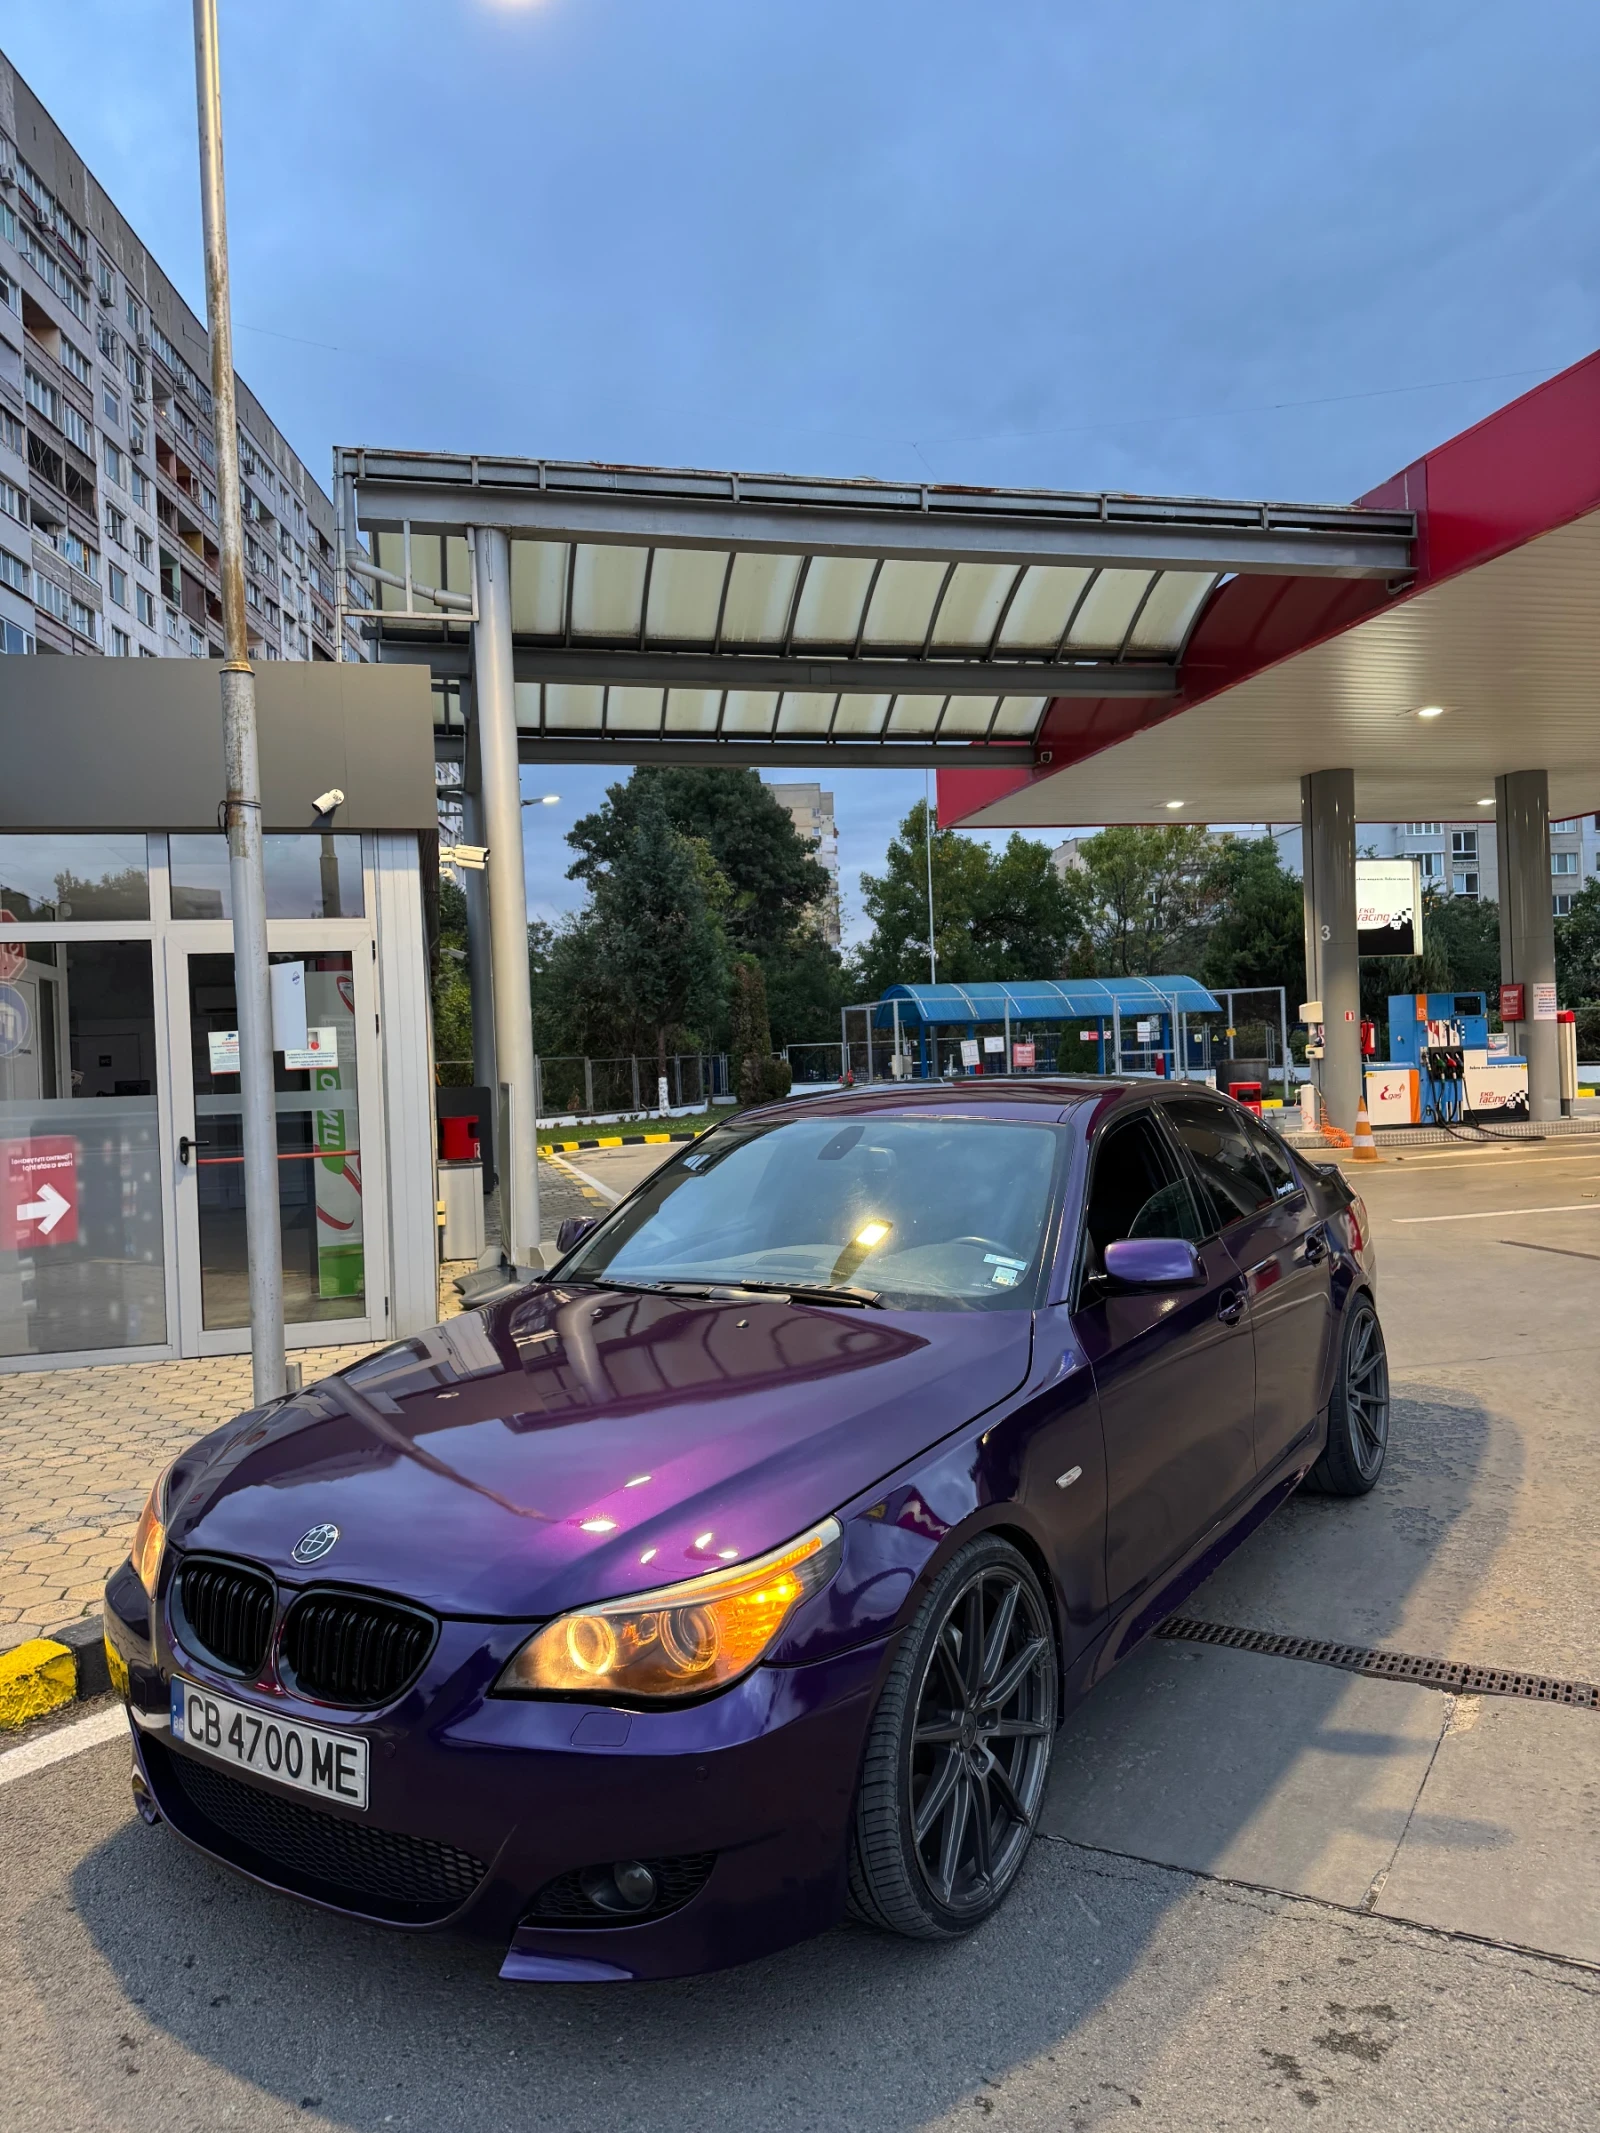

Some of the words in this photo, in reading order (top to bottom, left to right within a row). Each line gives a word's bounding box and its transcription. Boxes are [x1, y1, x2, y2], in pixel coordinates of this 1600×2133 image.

[1357, 913, 1390, 923] racing
[1321, 925, 1331, 941] 3
[1479, 1095, 1506, 1105] racing
[173, 1715, 184, 1731] BG
[188, 1694, 222, 1748] CB
[228, 1712, 303, 1779] 4700
[312, 1737, 358, 1798] ME
